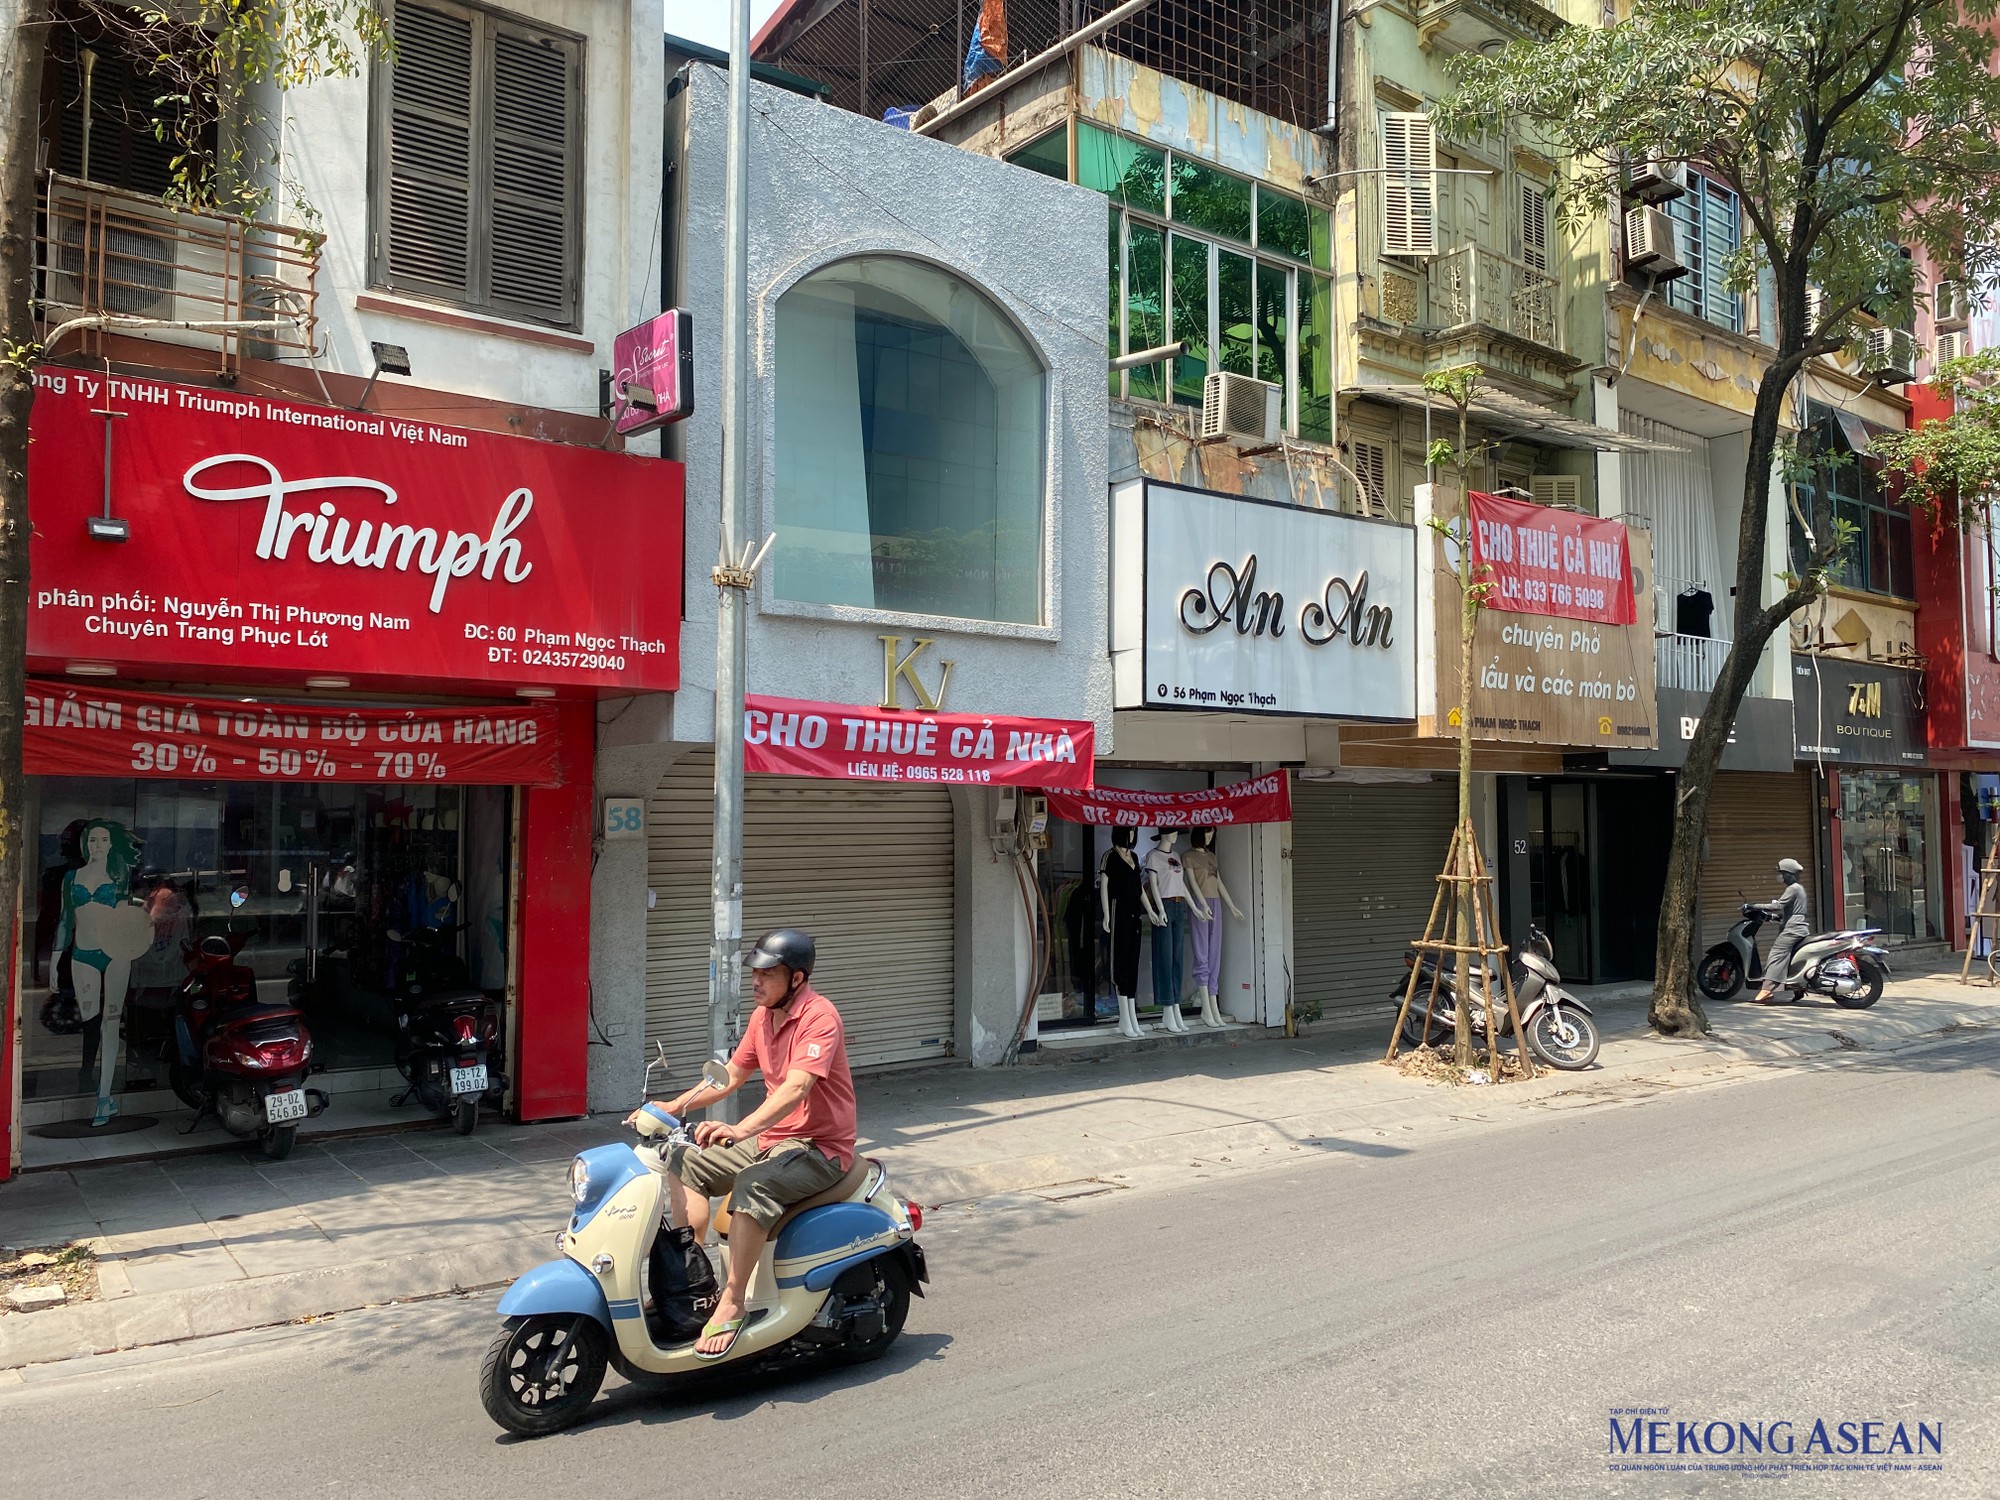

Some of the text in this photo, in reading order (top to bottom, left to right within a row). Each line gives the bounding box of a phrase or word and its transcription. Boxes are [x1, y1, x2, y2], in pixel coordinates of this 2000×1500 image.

[74, 375, 99, 399] Ty
[107, 380, 169, 405] TNHH
[176, 390, 260, 420] Triumph
[266, 403, 385, 436] International
[390, 421, 424, 445] Việt
[429, 427, 468, 448] Nam
[183, 453, 534, 614] Triumph
[1477, 519, 1514, 564] CHO
[1517, 524, 1560, 571] THUÊ
[1563, 524, 1586, 576] CẢ
[1589, 536, 1623, 581] NHÀ
[1180, 553, 1394, 650] An An
[1502, 575, 1604, 610] LH: 033 766 5098
[38, 588, 411, 631] phân phối: Nguyễn Thị Phương Nam
[84, 615, 328, 648] Chuyên Trang Phục Lót
[524, 628, 570, 649] Phạm
[575, 632, 616, 653] Ngọc
[619, 636, 666, 656] Thạch
[1502, 622, 1601, 655] chuyên Phở
[488, 647, 625, 671] ĐT: 02435729040
[1480, 655, 1636, 702] lẩu và các món bò
[1173, 686, 1186, 699] 56
[1189, 688, 1216, 703] Phạm
[1220, 690, 1245, 706] Ngọc
[23, 690, 538, 747] GIẢM GIÁ TOÀN BỘ CỦA HÀNG
[1836, 724, 1892, 739] BOUTIQUE
[744, 709, 1078, 764] CHO THUÊ CẢ NHÀ
[131, 742, 217, 773] 30%
[258, 748, 336, 776] 50%
[373, 751, 447, 779] 70%
[847, 761, 991, 783] LIÊN HỆ: 0965 528 118
[607, 806, 642, 832] 58
[1514, 839, 1527, 854] 52
[455, 1078, 486, 1092] 199.02
[456, 1067, 481, 1081] 29-T2
[269, 1104, 305, 1121] 546.89
[272, 1092, 300, 1108] 29-D2
